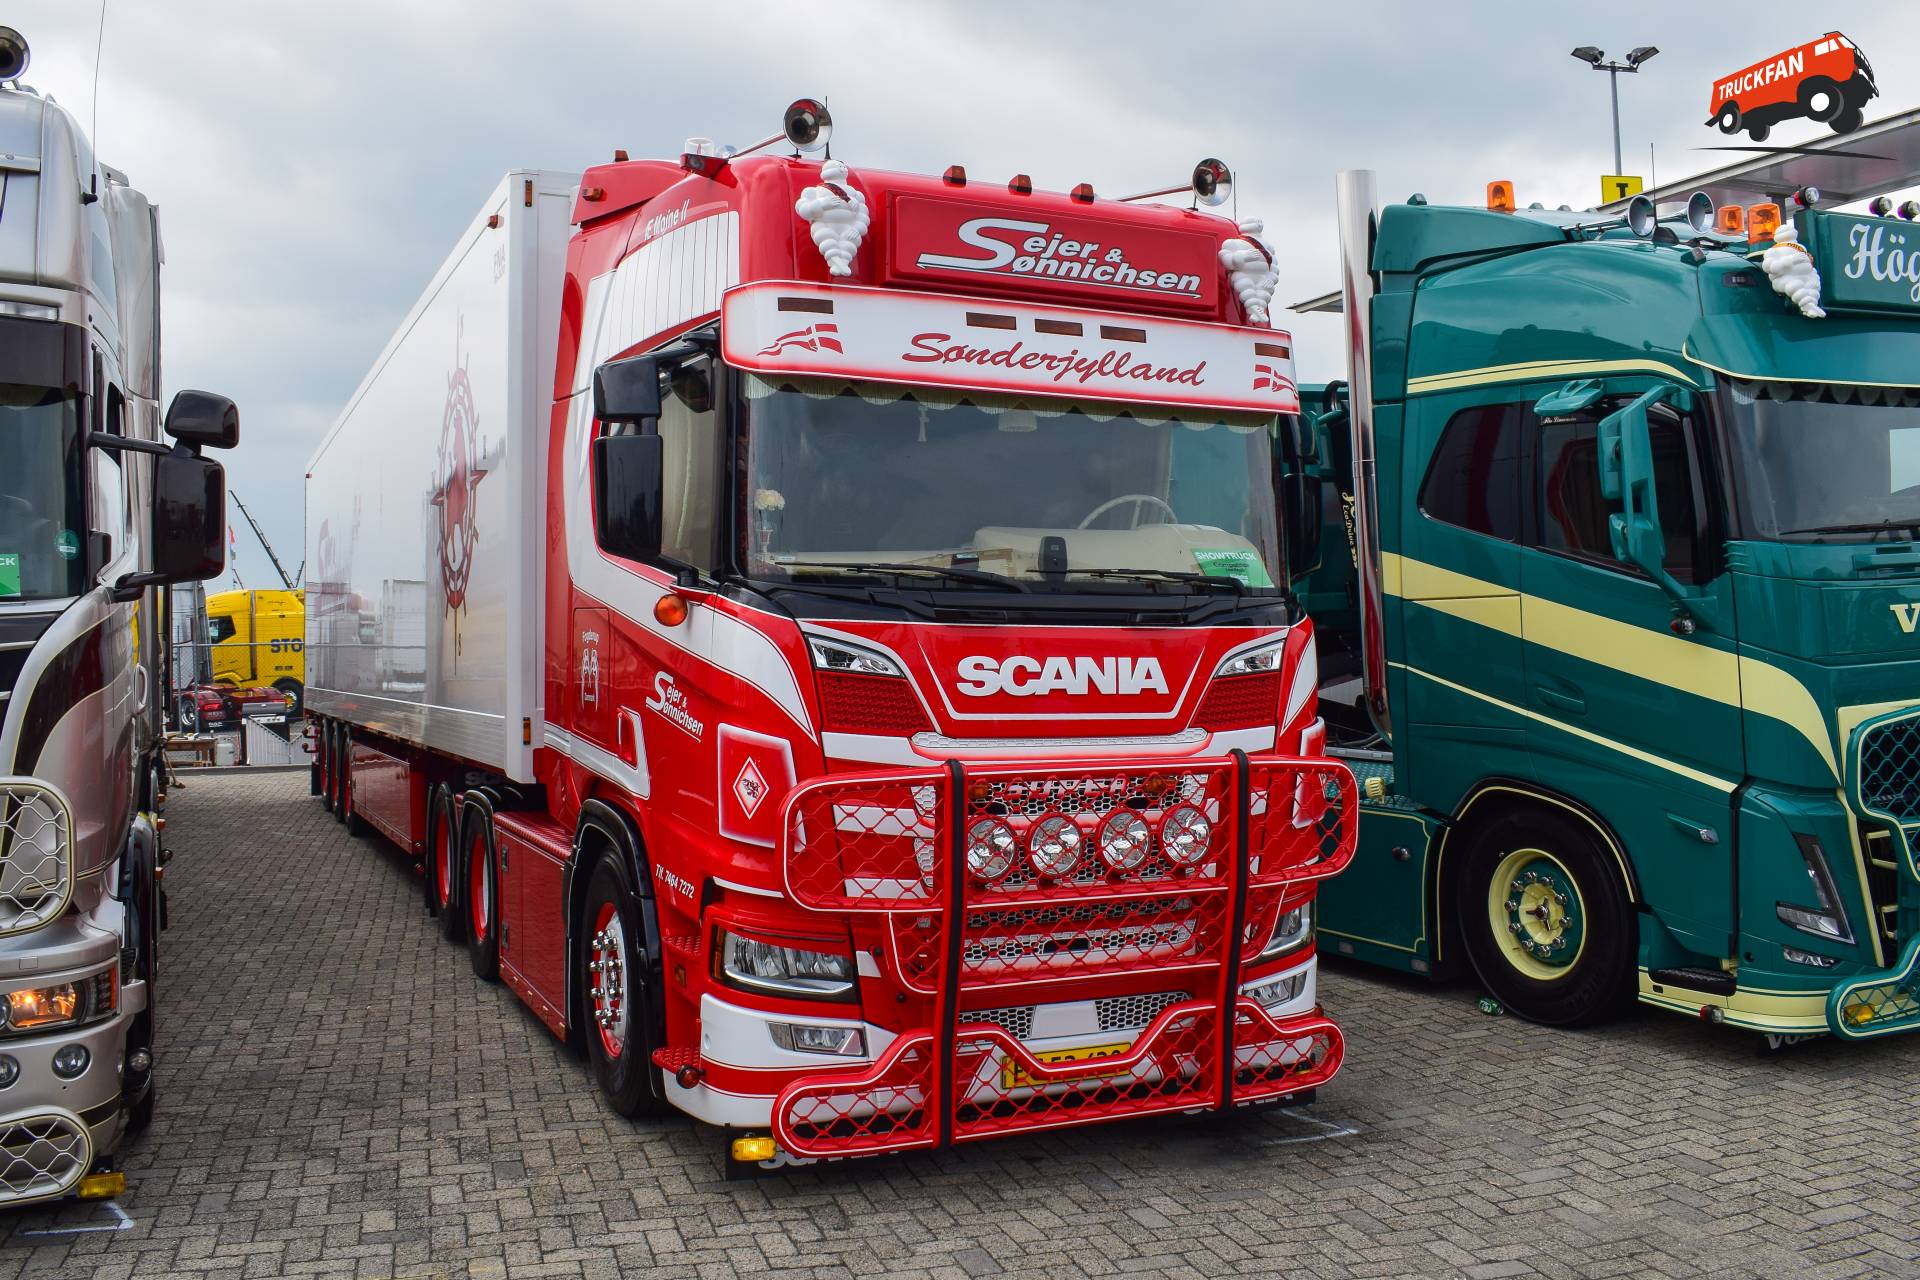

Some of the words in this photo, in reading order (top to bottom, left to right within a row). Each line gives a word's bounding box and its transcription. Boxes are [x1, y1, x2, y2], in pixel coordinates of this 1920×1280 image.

[1616, 183, 1629, 198] T
[917, 217, 1099, 270] Sejer
[1104, 248, 1123, 263] &
[901, 332, 1207, 387] Sønderjylland
[1195, 552, 1257, 560] SHOWTRUCK
[957, 656, 1170, 697] SCANIA
[665, 869, 679, 889] 7464
[678, 879, 695, 899] 7272
